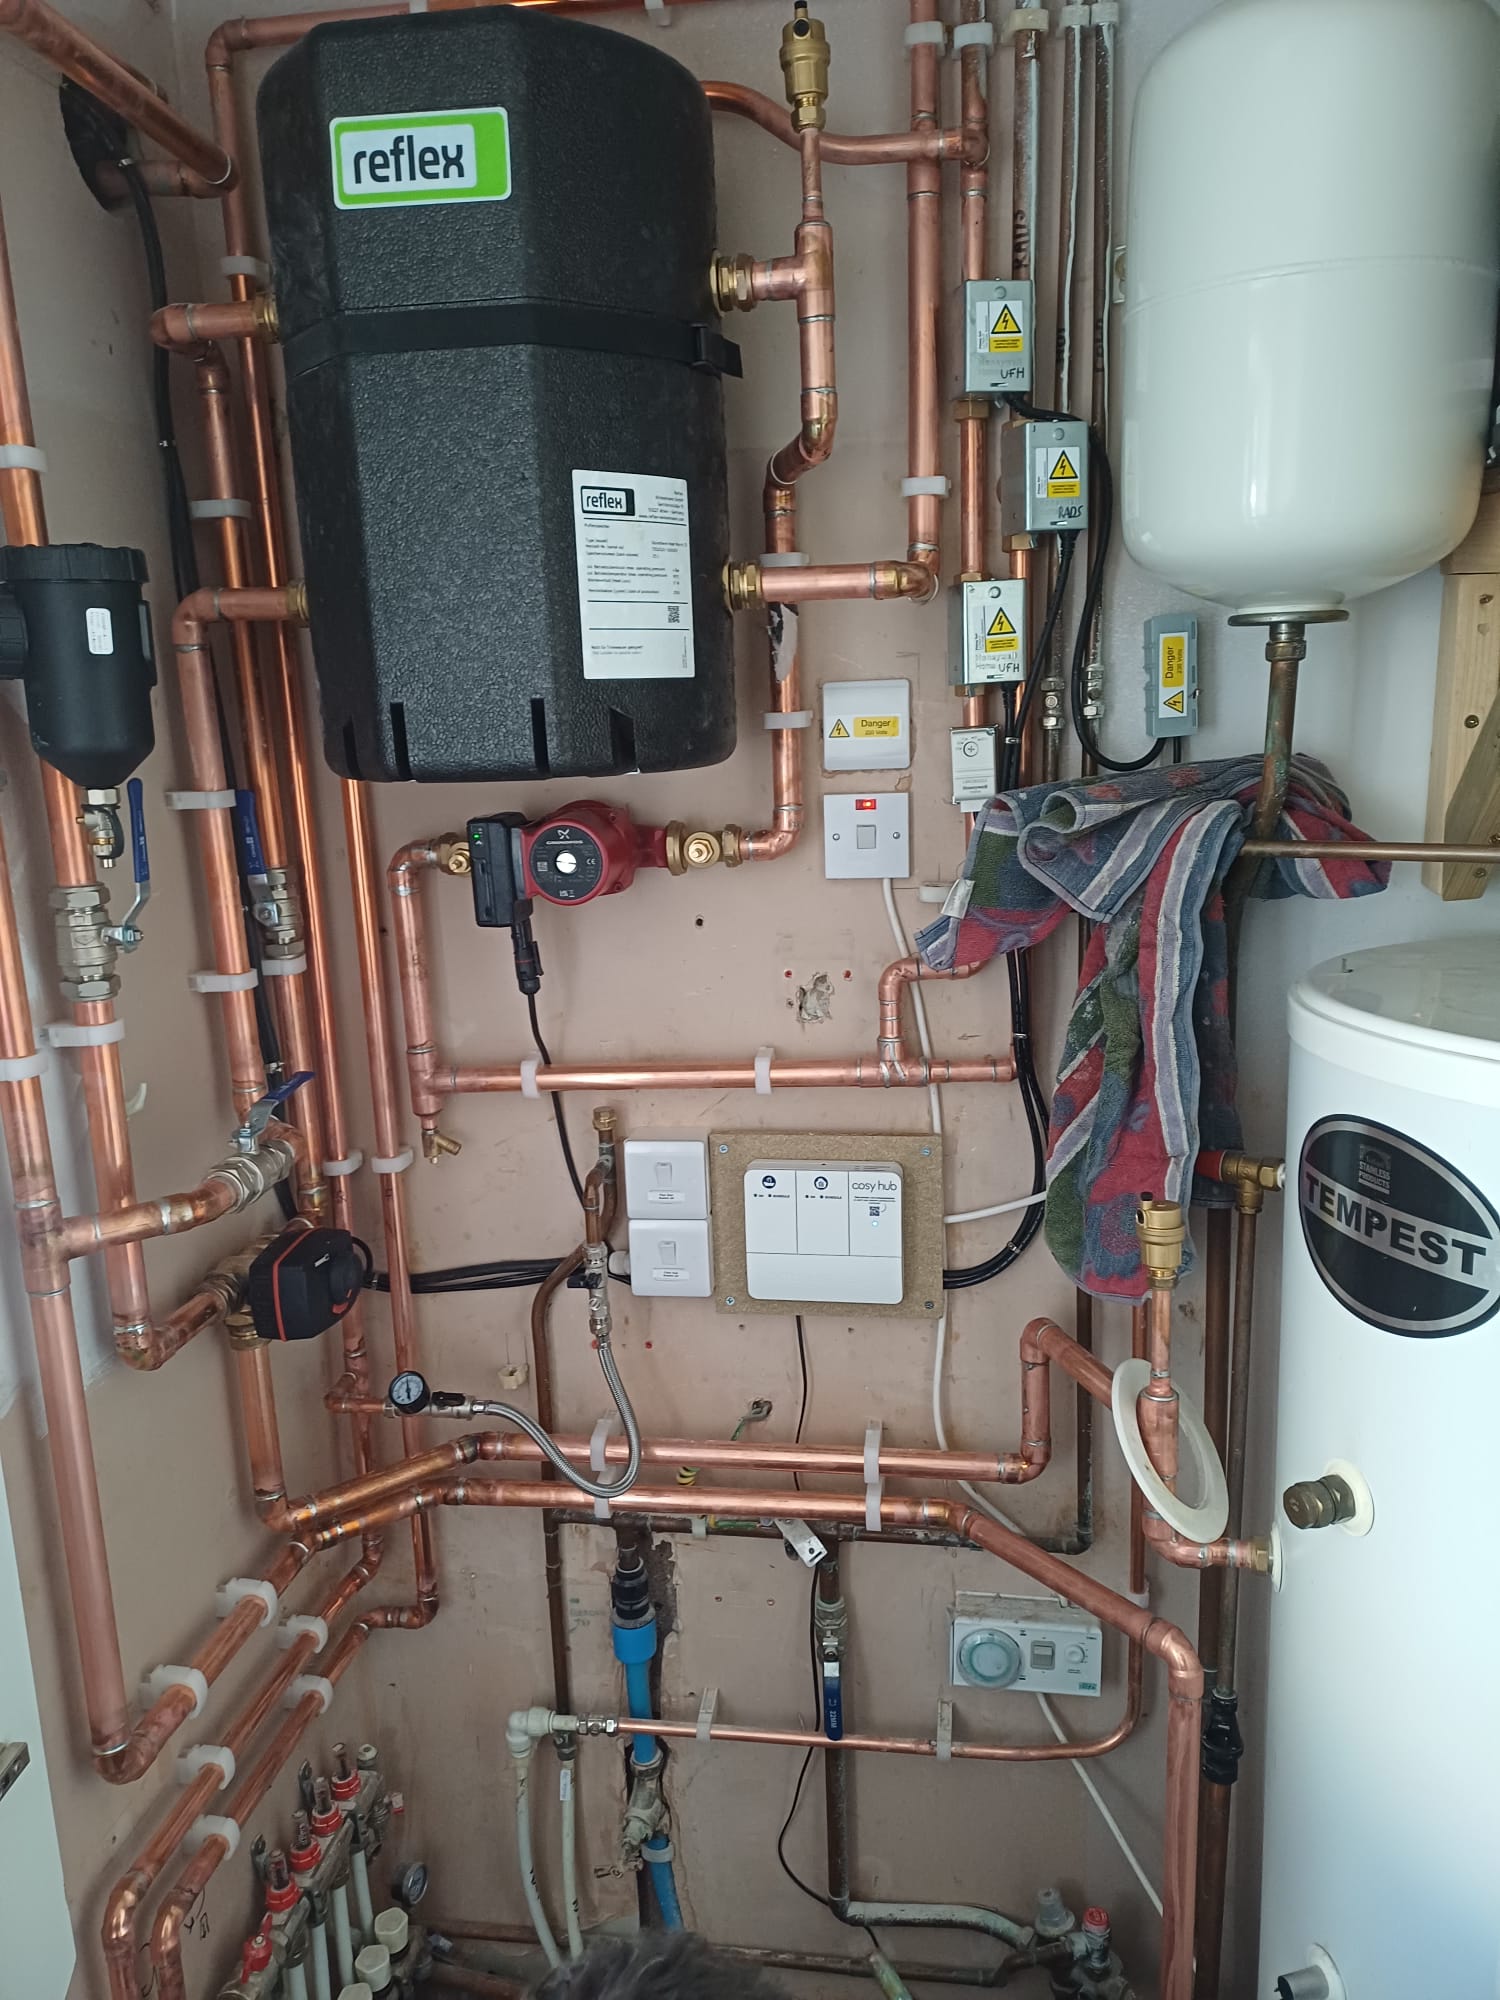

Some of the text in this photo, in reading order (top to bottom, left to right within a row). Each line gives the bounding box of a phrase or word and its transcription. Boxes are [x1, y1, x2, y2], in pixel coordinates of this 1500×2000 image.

[353, 134, 465, 184] reflex
[1000, 367, 1025, 379] UFH
[586, 491, 622, 509] reflex
[1058, 505, 1084, 519] RADS
[998, 662, 1020, 673] UFH
[1165, 646, 1176, 679] Danger
[861, 719, 891, 728] Danger
[1358, 1170, 1391, 1189] PRODUCTS
[1359, 1160, 1391, 1181] STAINLESS
[852, 1180, 898, 1193] cosy hub
[1306, 1170, 1487, 1276] TEMPEST
